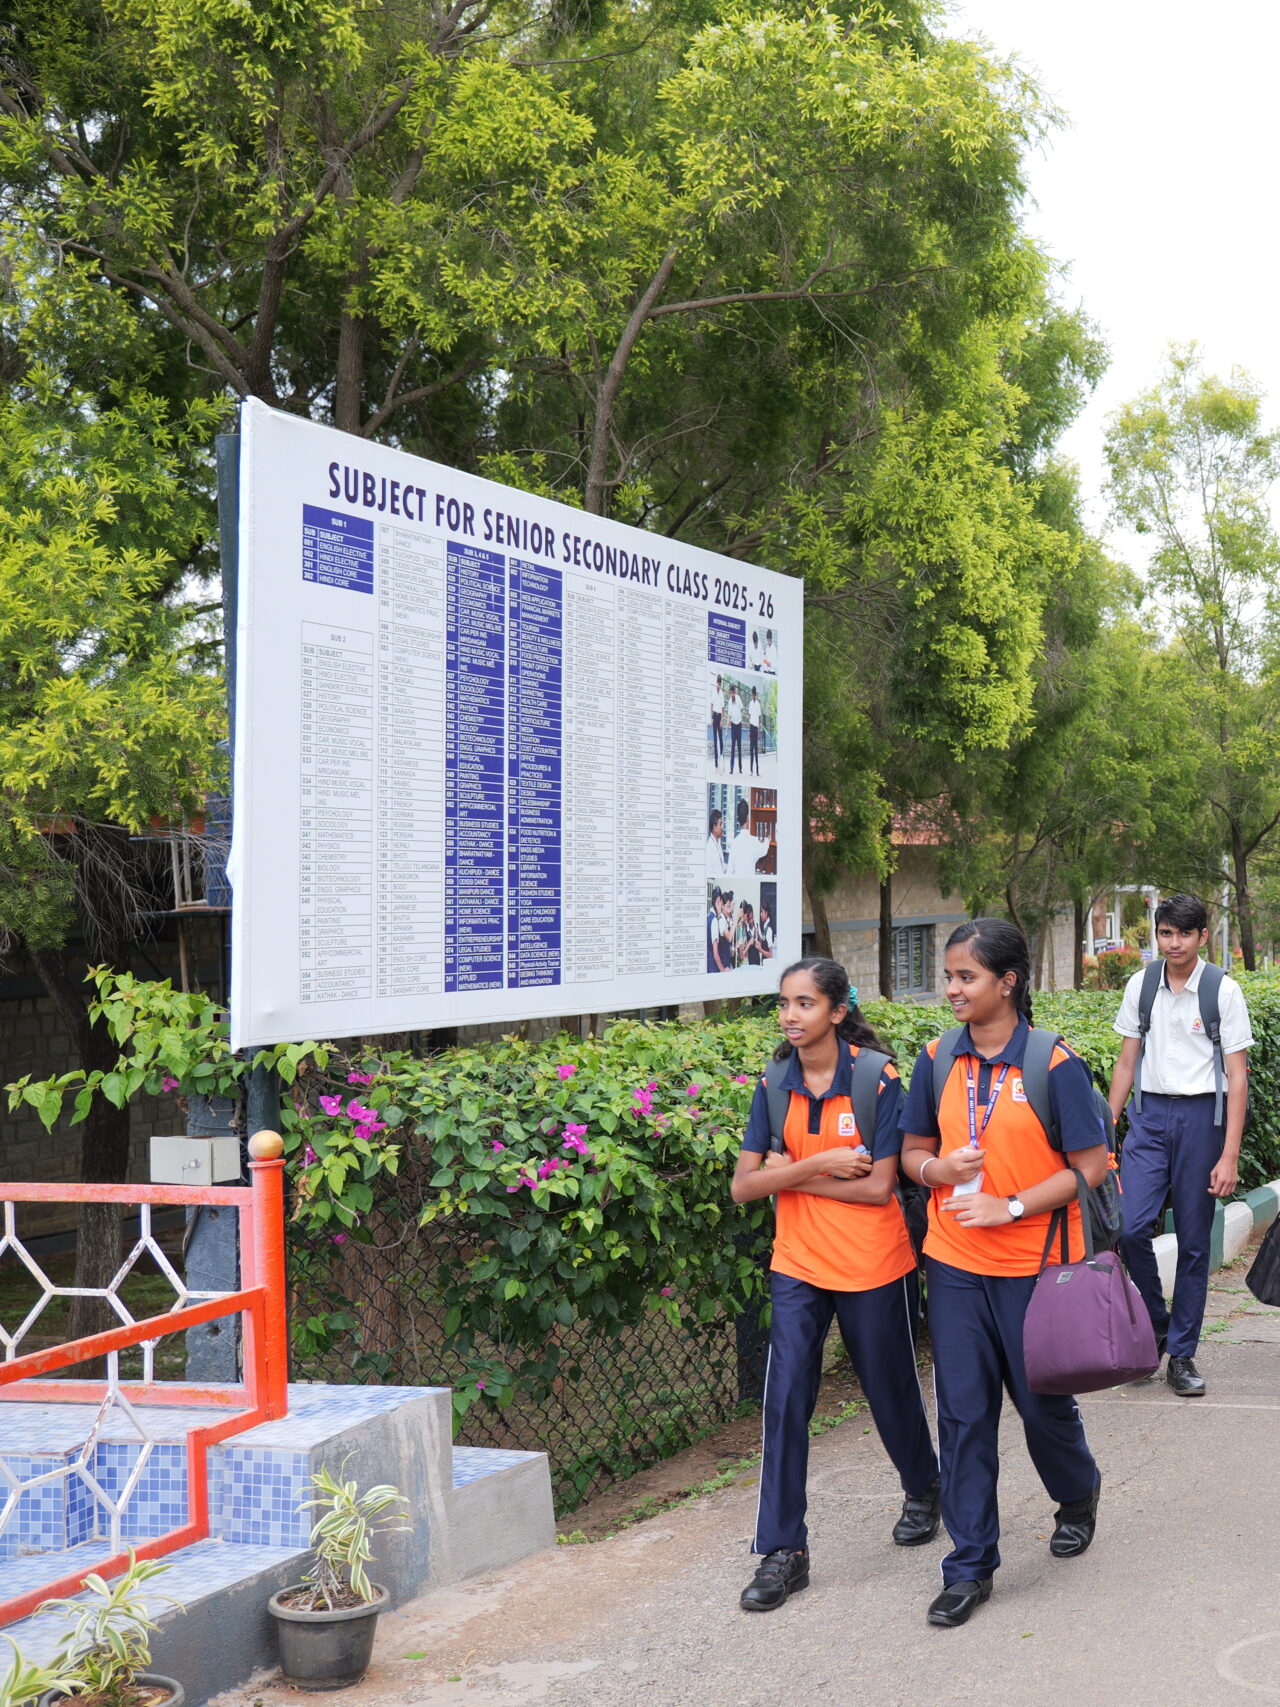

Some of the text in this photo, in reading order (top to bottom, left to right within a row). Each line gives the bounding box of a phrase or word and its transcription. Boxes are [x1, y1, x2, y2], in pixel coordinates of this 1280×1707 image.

[331, 517, 342, 527] SUB
[303, 526, 344, 543] SUB SUBJECT
[329, 462, 426, 522] SUBJECT
[435, 493, 475, 536] FOR
[483, 508, 555, 559] SENIOR
[563, 532, 661, 587] SECONDARY
[667, 564, 708, 600] CLASS
[759, 591, 774, 619] 26
[319, 541, 342, 554] ENGLISH
[343, 547, 367, 559] ELECTIVE
[319, 552, 334, 562] HINDI
[334, 555, 359, 568] ELECTIVE
[319, 563, 342, 575] ENGLISH
[342, 568, 357, 578] CORE
[319, 574, 333, 584] HINDI
[334, 577, 350, 587] CORE
[330, 633, 341, 642] SUB
[303, 645, 342, 658] SUB SUBJECT
